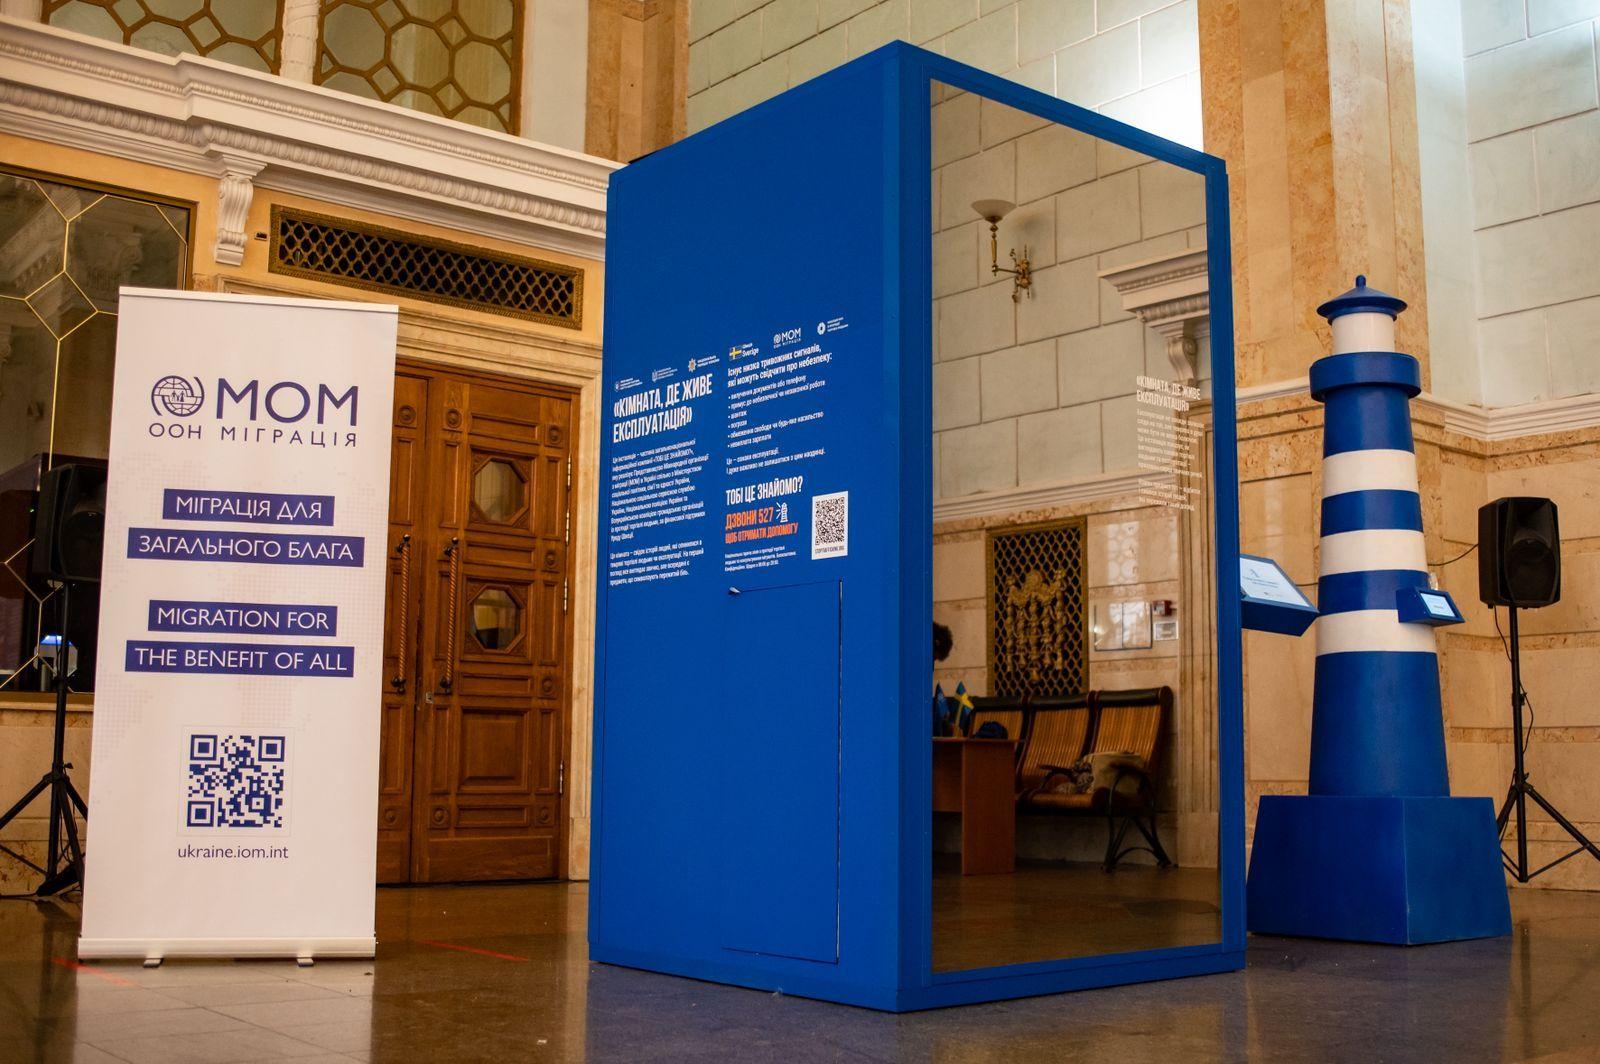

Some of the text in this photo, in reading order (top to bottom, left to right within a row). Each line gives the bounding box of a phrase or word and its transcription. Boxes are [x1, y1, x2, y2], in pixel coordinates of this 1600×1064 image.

[786, 363, 797, 373] про
[216, 378, 358, 426] МОМ
[614, 388, 663, 418] «КІМНАТА,
[665, 383, 680, 407] ДЕ
[682, 373, 713, 401] ЖИВЕ
[1171, 383, 1182, 396] ДЕ
[1182, 385, 1201, 400] ЖИВЕ
[149, 423, 357, 448] ООН МІГРАЦІЯ
[613, 406, 693, 443] ЕКСПЛУАТАЦІЯ»
[726, 476, 803, 506] ТОБІ ЦЕ ЗНАЙОМО?
[176, 496, 322, 521] МІГРАЦІЯ ДЛЯ
[725, 506, 774, 530] ДЗВОНИ 527
[767, 522, 799, 539] ДОПОМОГУ
[139, 535, 354, 560] ЗАГАЛЬНОГО БЛАГА
[157, 608, 329, 630] MIGRATION FOR
[135, 648, 348, 671] THE BENEFIT OF ALL
[178, 845, 289, 859] ukraine.iom.int
